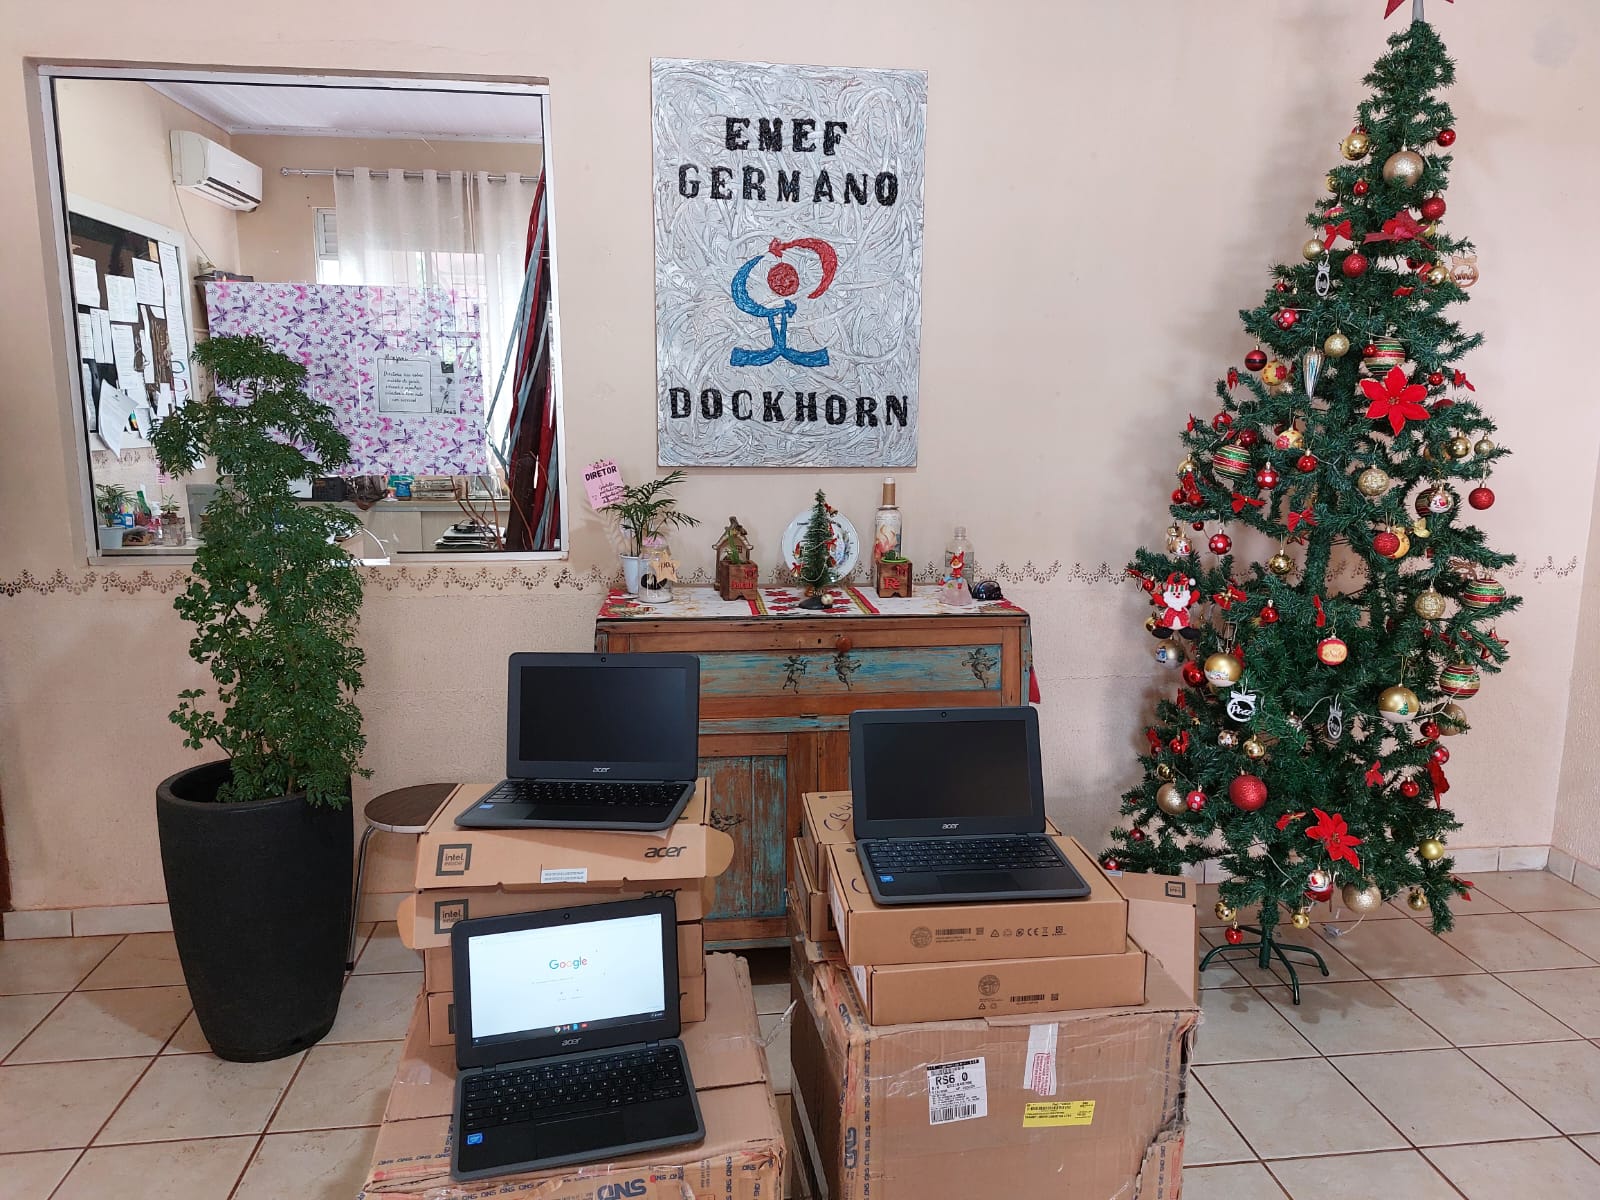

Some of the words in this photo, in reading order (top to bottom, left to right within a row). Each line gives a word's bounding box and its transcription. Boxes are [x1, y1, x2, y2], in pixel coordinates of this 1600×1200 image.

[725, 117, 847, 156] EMEF
[678, 163, 899, 207] GERMANO
[669, 387, 908, 427] DOCKHORN
[585, 465, 617, 481] DIRETOR
[644, 846, 687, 858] acer
[442, 909, 461, 919] intel
[548, 956, 588, 971] Google
[561, 1037, 582, 1047] acer
[936, 1074, 956, 1086] RS6
